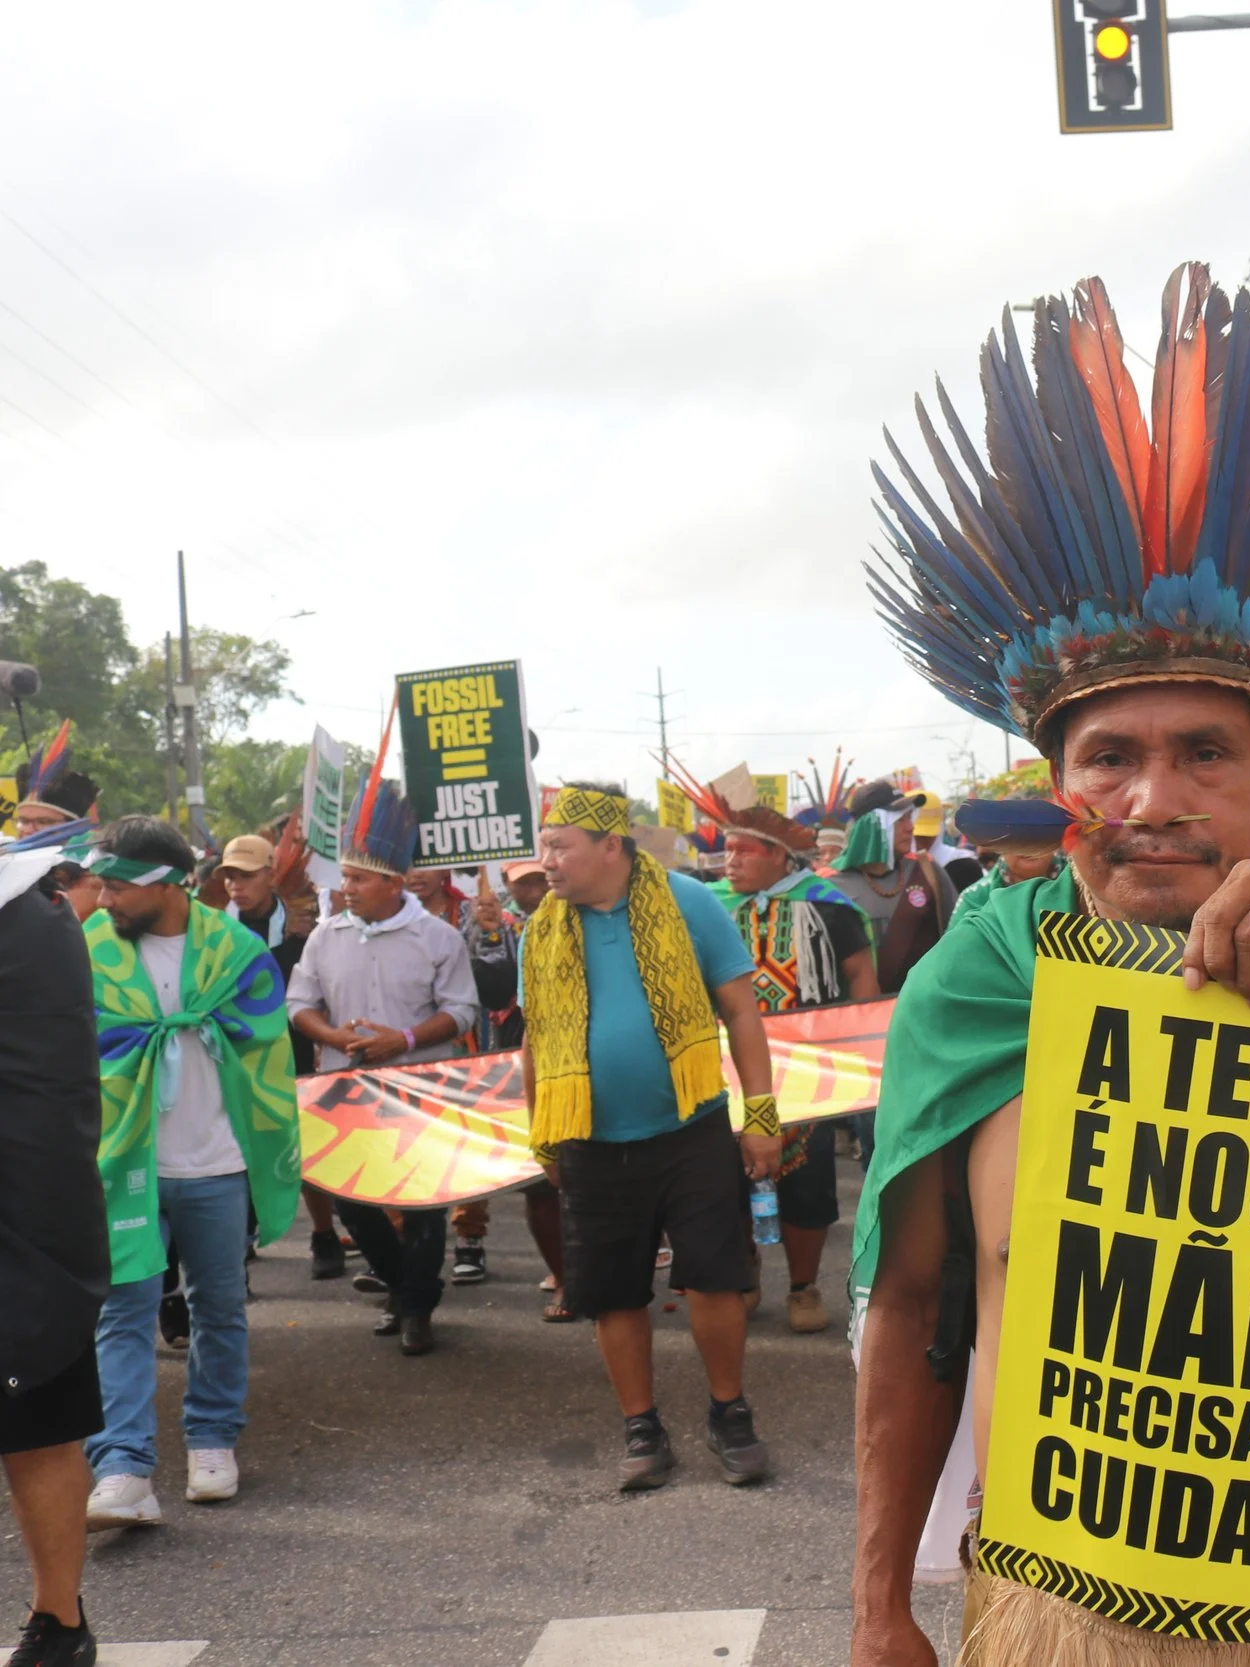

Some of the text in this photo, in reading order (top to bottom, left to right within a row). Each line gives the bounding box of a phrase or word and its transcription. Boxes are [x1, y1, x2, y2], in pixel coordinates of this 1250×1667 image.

[412, 674, 504, 717] FOSSIL
[427, 710, 493, 750] FREE
[434, 780, 499, 821] JUST
[419, 814, 524, 857] FUTURE
[1076, 1005, 1131, 1103] A
[1066, 1097, 1111, 1206] É
